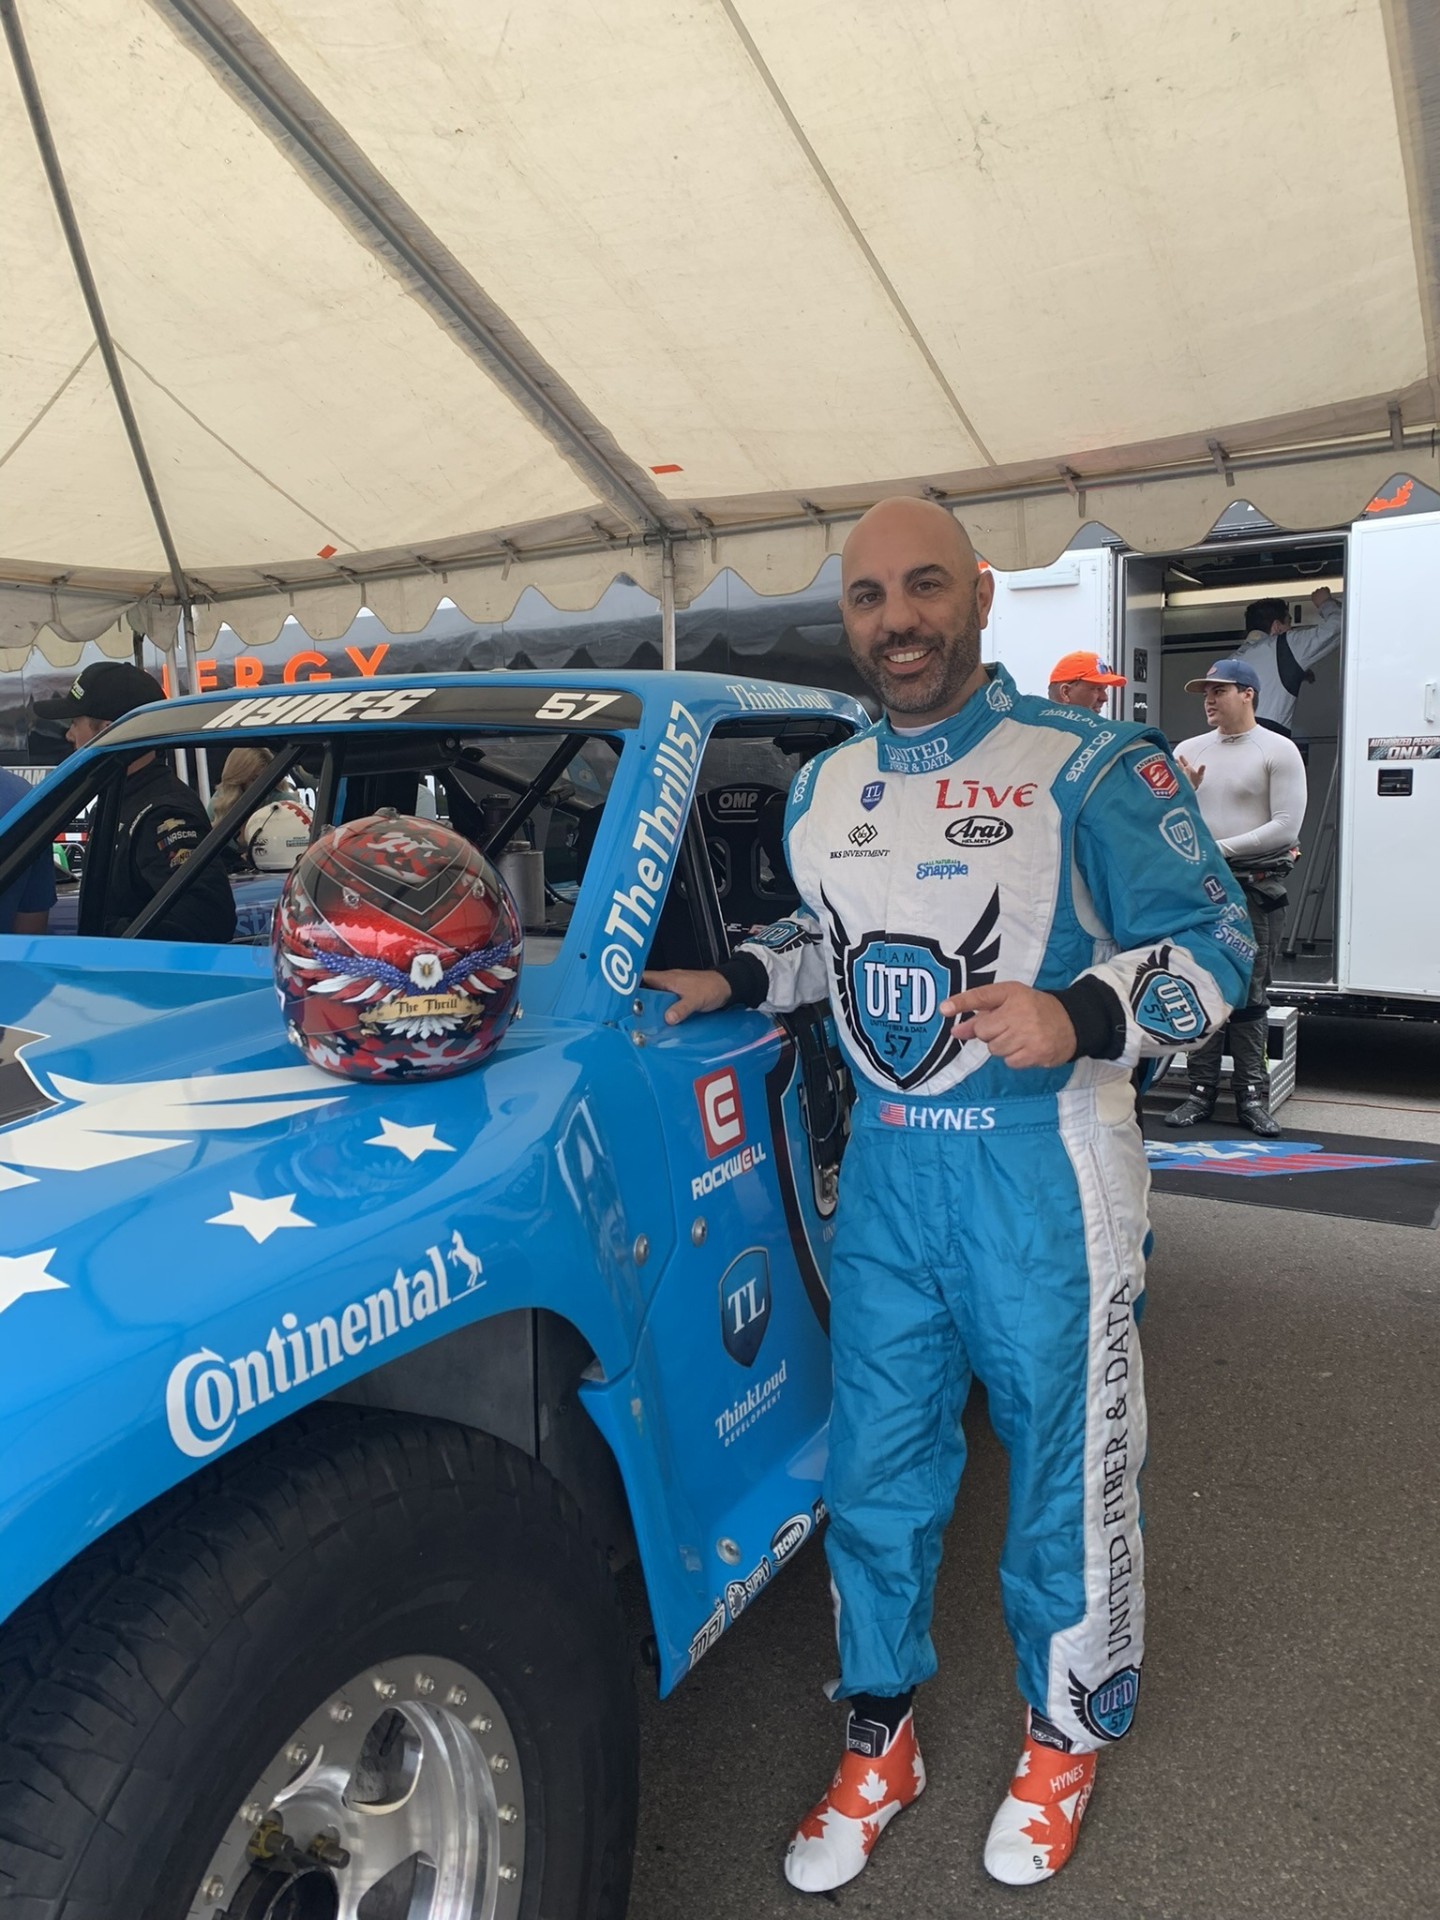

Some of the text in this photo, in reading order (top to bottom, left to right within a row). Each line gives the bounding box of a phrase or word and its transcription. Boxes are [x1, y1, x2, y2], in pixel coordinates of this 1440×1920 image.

[161, 643, 391, 700] ERGY
[202, 688, 437, 729] HYNES
[535, 692, 622, 721] 57
[725, 684, 833, 711] ThinkLoud
[885, 737, 949, 762] UNITED
[912, 762, 920, 772] &
[921, 752, 954, 772] DATA
[1386, 745, 1433, 760] ONLY
[718, 792, 757, 809] OMP
[866, 785, 882, 798] TL
[166, 830, 198, 846] NASCAR
[946, 819, 1006, 838] Arai
[1168, 820, 1194, 844] UFD
[600, 700, 702, 996] @TheThrill57
[843, 849, 890, 858] INVESTMENT
[916, 860, 969, 880] Snapple
[1205, 878, 1222, 896] TL
[876, 947, 916, 964] TAM
[395, 998, 458, 1014] The Thrill
[863, 962, 936, 1024] UFD
[1157, 980, 1197, 1032] UFD
[1143, 1004, 1166, 1023] 57
[884, 1032, 912, 1059] 57
[909, 1106, 996, 1131] HYNES
[691, 1142, 767, 1201] ROCKWELL
[728, 1277, 766, 1335] TL
[165, 1245, 452, 1458] Continental
[714, 1359, 788, 1440] ThinkLoud
[724, 1391, 782, 1448] DEVELOPMENT
[1103, 1280, 1133, 1660] UNITED FIBER & DATA
[744, 1562, 771, 1599] SUPPLY
[1099, 1680, 1133, 1715] UFD
[1050, 1763, 1085, 1794] HYNES
